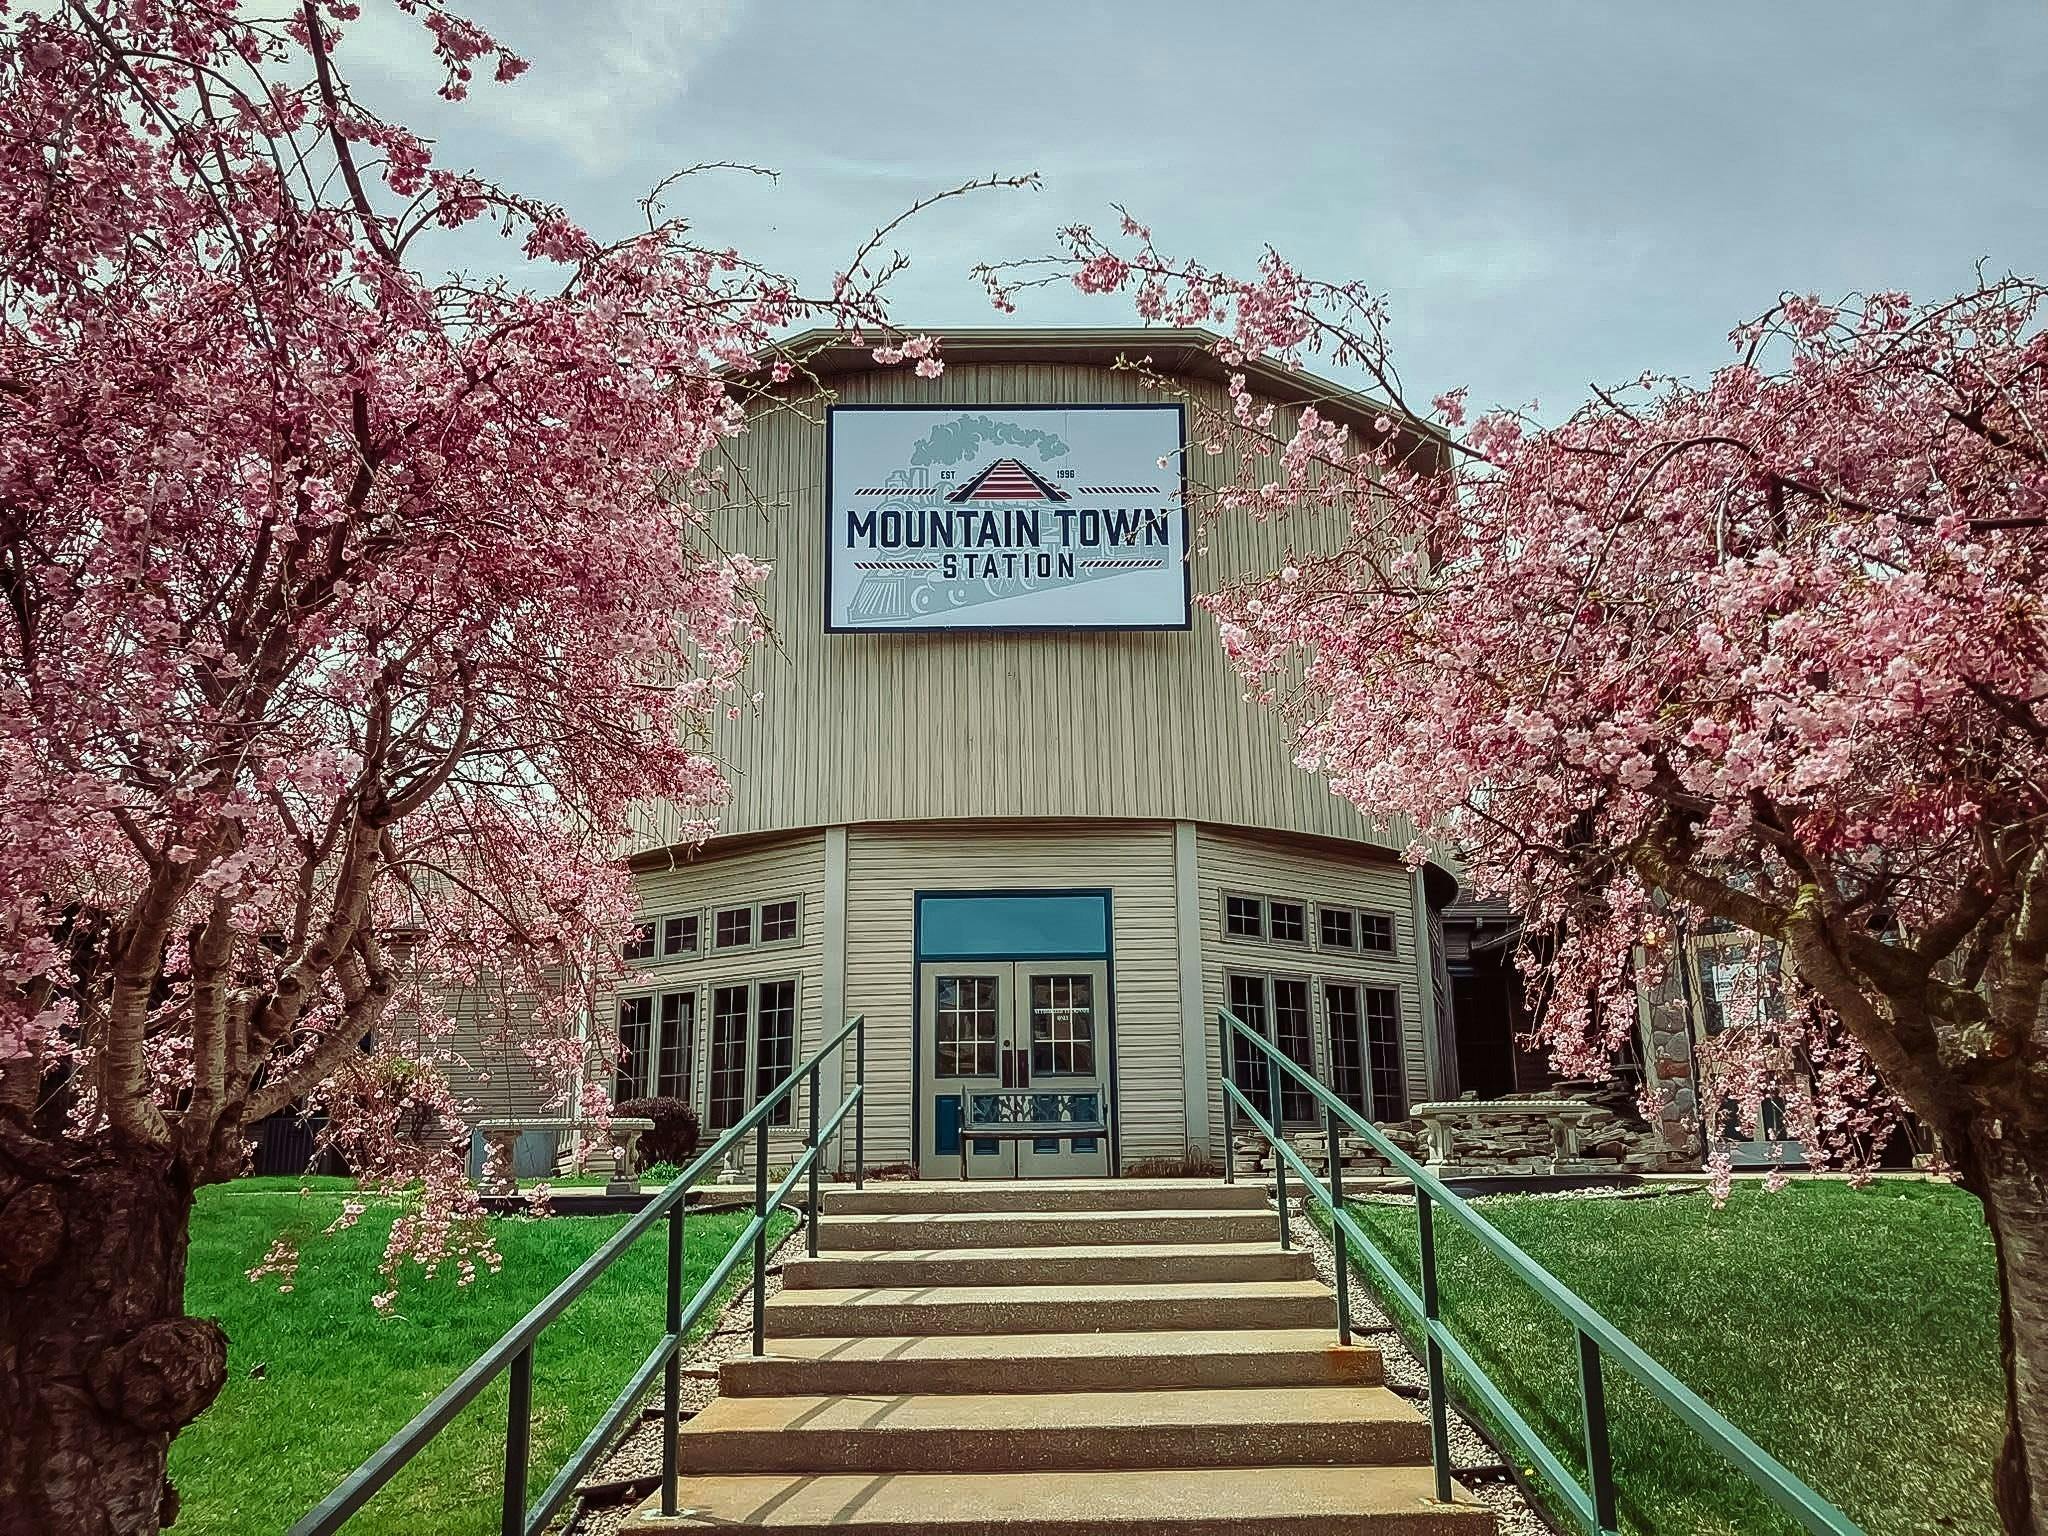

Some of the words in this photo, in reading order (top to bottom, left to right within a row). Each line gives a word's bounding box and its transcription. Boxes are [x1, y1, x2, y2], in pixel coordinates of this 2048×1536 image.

[1056, 469, 1075, 479] 1996
[846, 509, 1041, 549] MOUNTAIN
[1053, 508, 1170, 547] TOWN
[942, 552, 1075, 579] STATION
